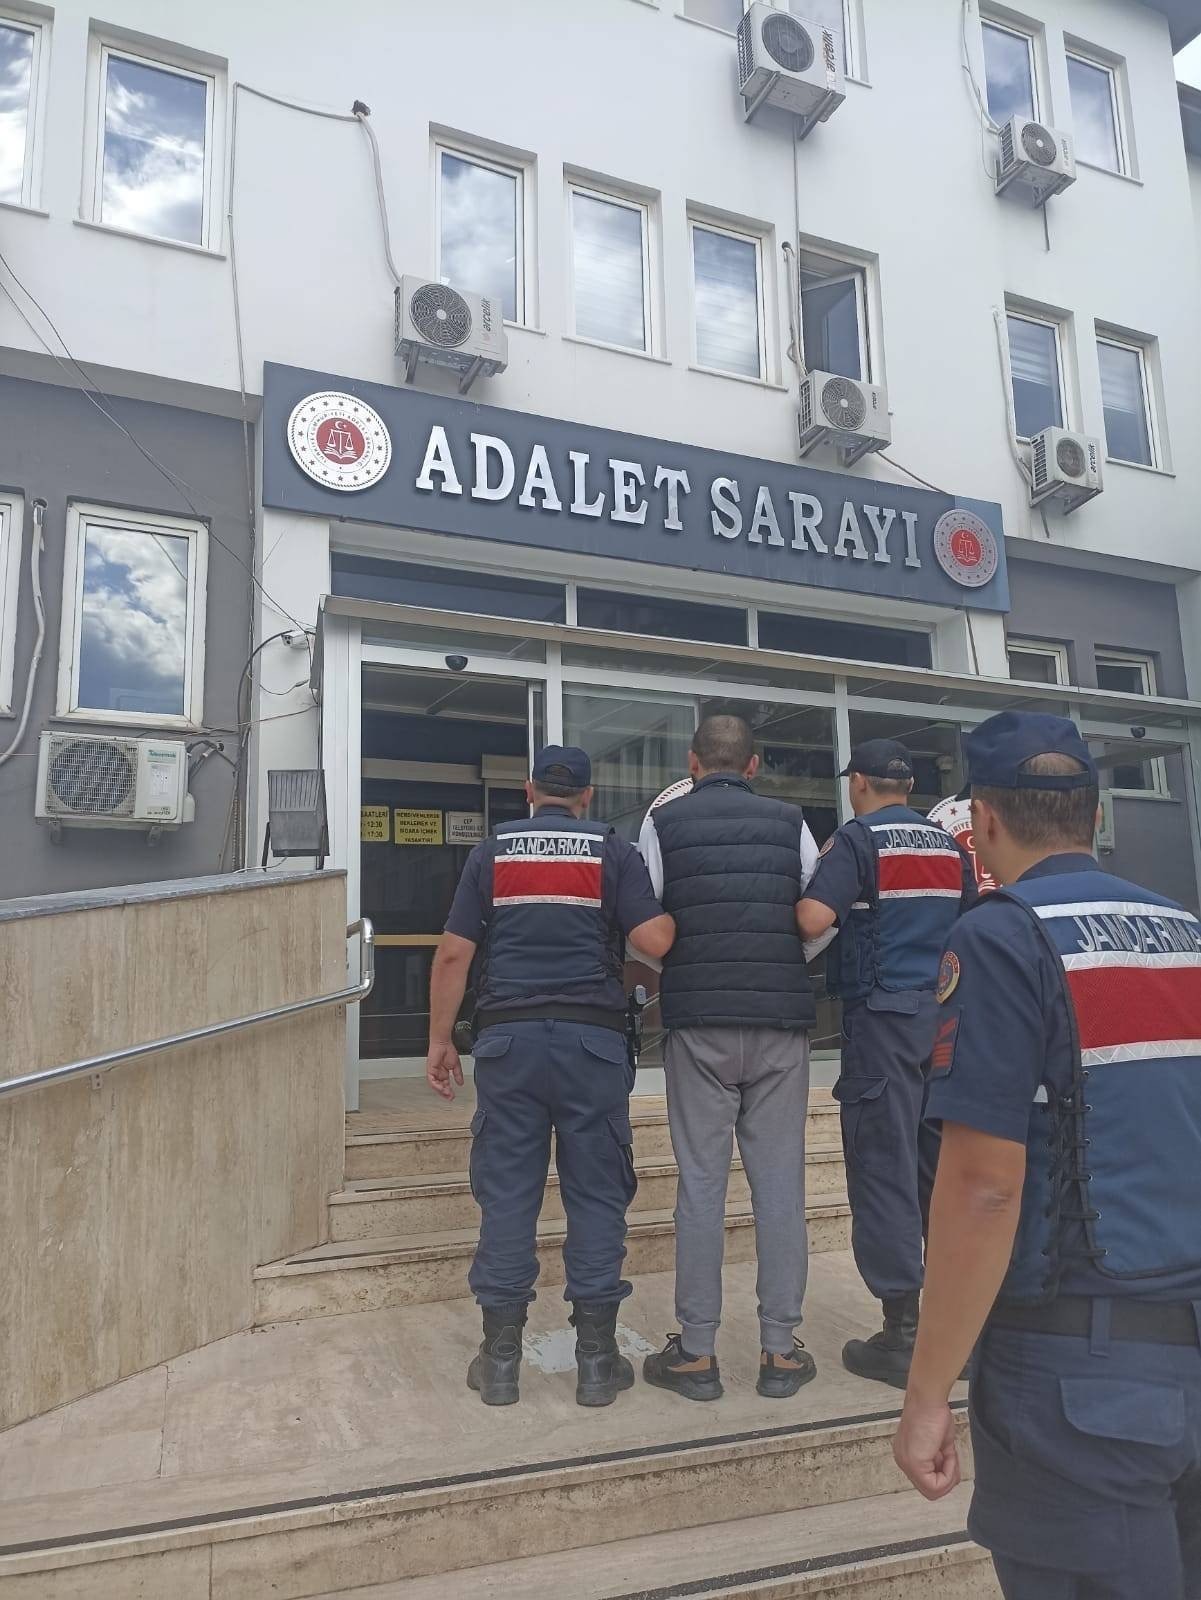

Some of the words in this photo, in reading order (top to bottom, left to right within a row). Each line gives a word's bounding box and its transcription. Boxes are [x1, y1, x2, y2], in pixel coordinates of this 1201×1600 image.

[415, 425, 691, 531] ADALET
[711, 477, 922, 568] SARAYI
[506, 838, 592, 856] JANDARMA
[886, 829, 951, 850] JANDARMA
